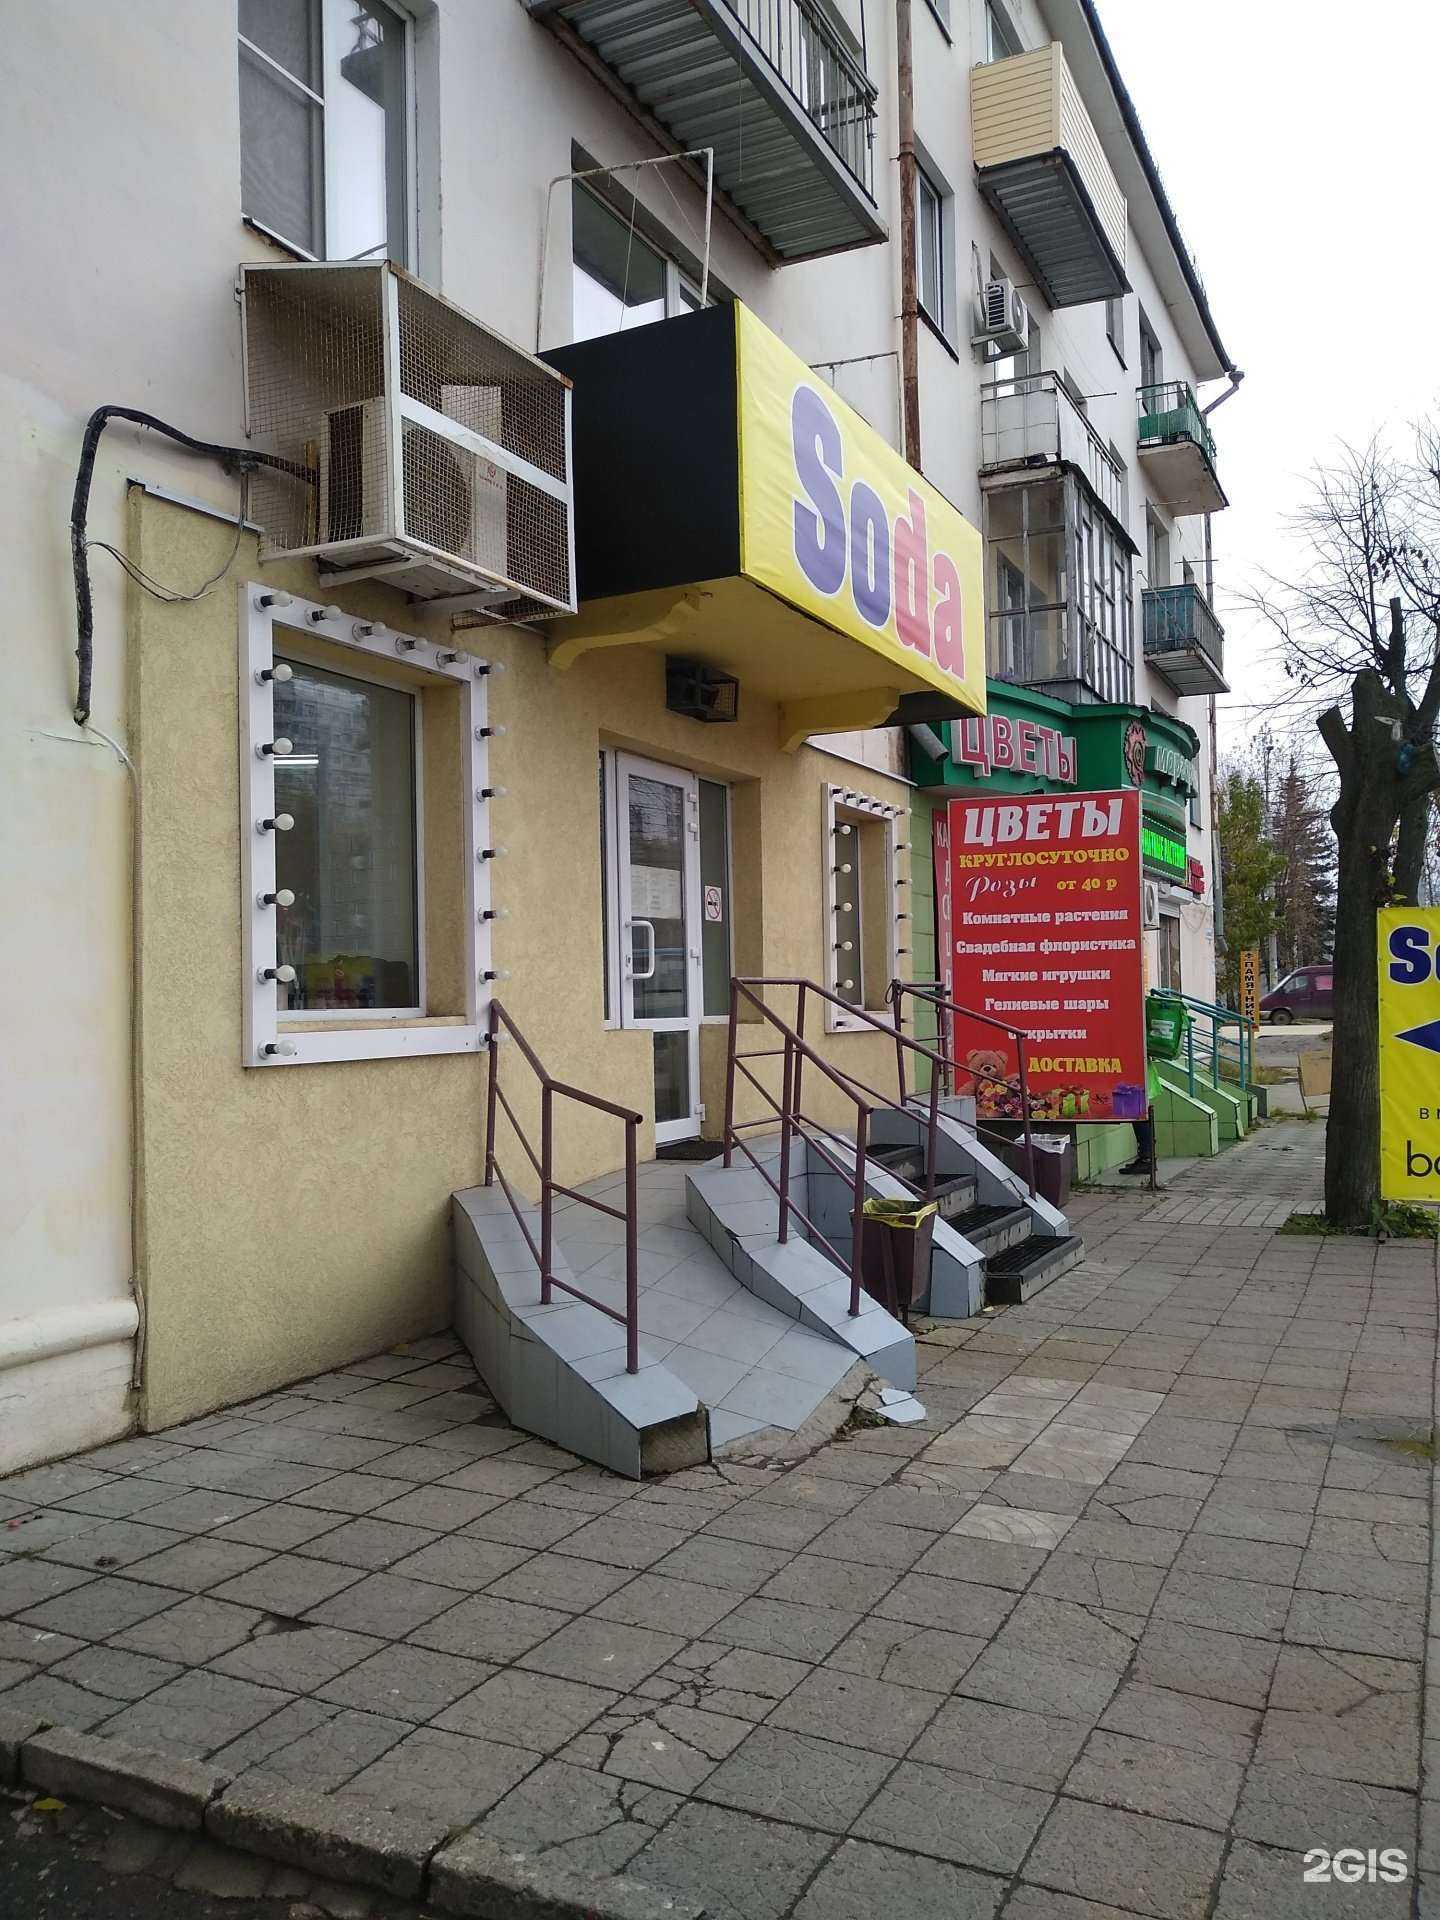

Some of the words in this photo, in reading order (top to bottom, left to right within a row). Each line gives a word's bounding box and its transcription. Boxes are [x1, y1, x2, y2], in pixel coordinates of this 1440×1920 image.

[791, 384, 965, 681] Soda
[957, 714, 1077, 784] ЦВЕТЫ
[963, 798, 1123, 847] ЦВЕТЫ
[959, 847, 1130, 869] КРУГЛОСУТОЧНО
[965, 874, 1038, 903] Розы
[1056, 879, 1077, 891] от
[1081, 877, 1101, 891] 40
[1106, 878, 1118, 891] р
[962, 911, 1051, 925] Комнатные
[1055, 909, 1129, 925] растения
[956, 941, 1036, 955] Свадебная
[1040, 938, 1136, 954] флористика
[982, 969, 1039, 982] Мягкие
[1042, 968, 1111, 984] игрушки
[984, 998, 1060, 1011] Гелиевые
[1063, 998, 1109, 1012] шары
[1028, 1056, 1122, 1074] ДОСТАВКА
